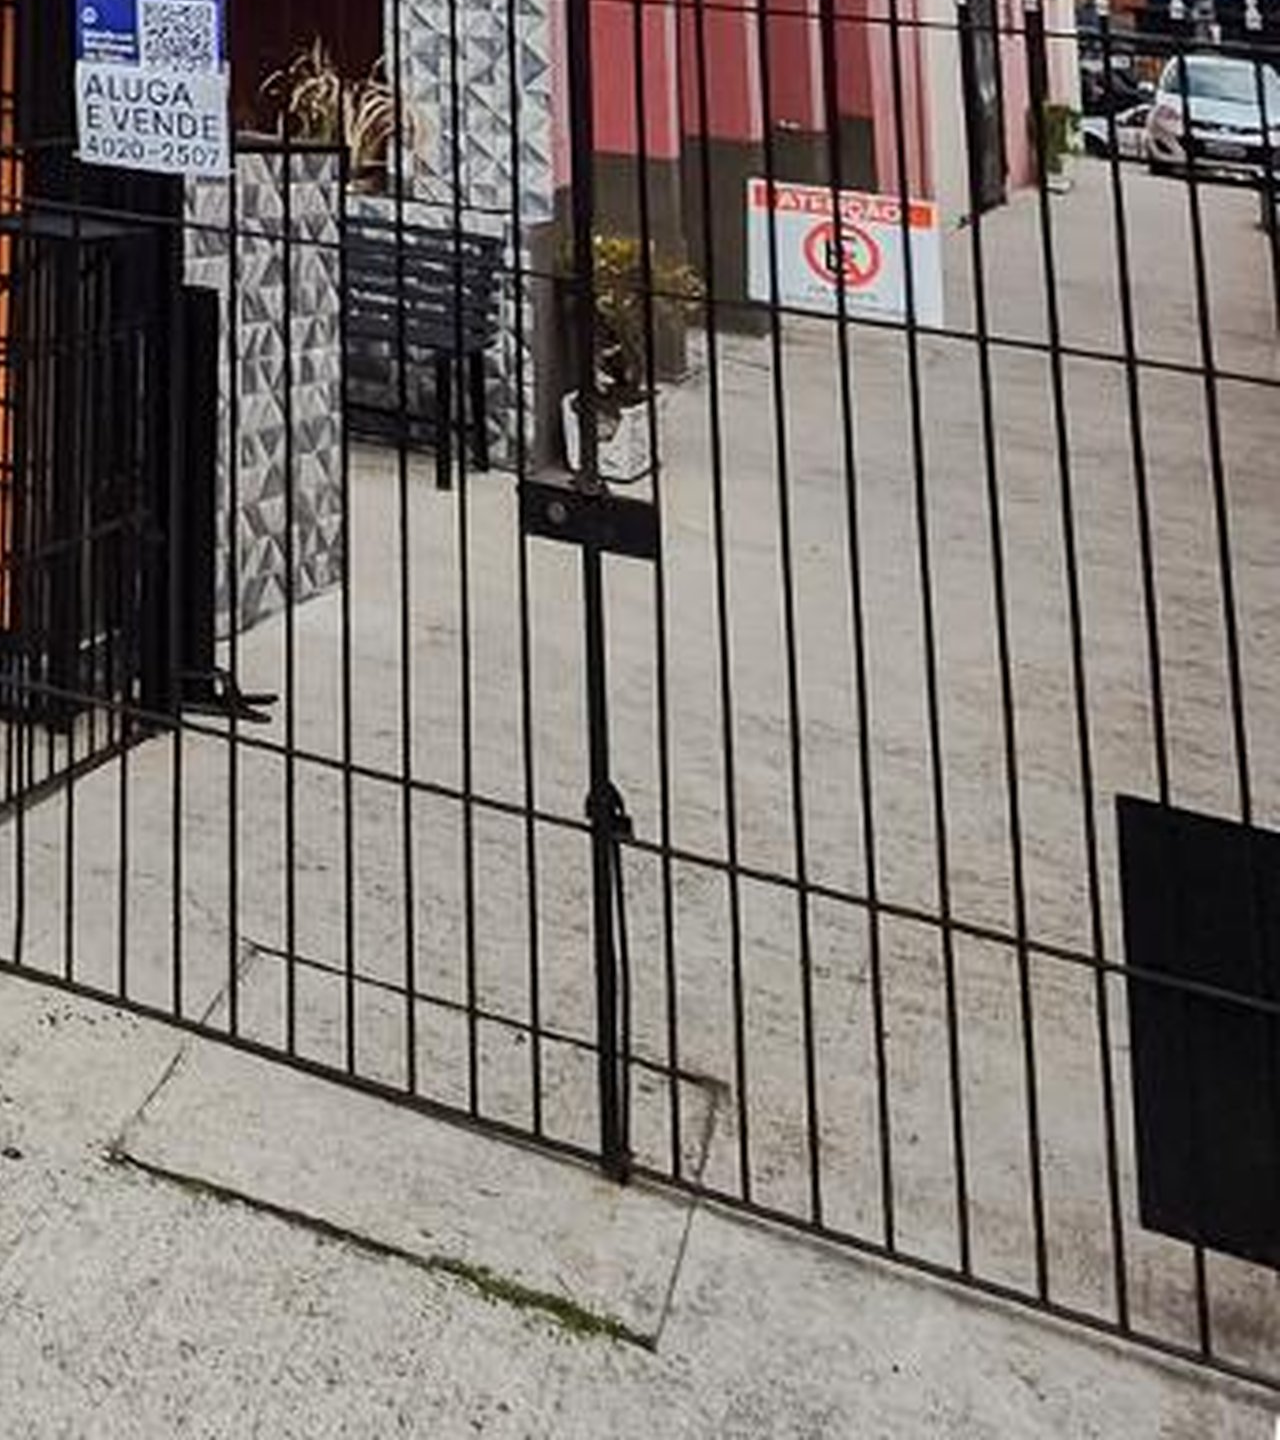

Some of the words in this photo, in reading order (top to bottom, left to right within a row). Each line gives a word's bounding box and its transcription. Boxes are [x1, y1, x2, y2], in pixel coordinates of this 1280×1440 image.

[84, 73, 193, 108] ALUGA
[86, 103, 103, 129] E
[110, 105, 220, 142] VENDE
[86, 134, 220, 167] 4020-2507
